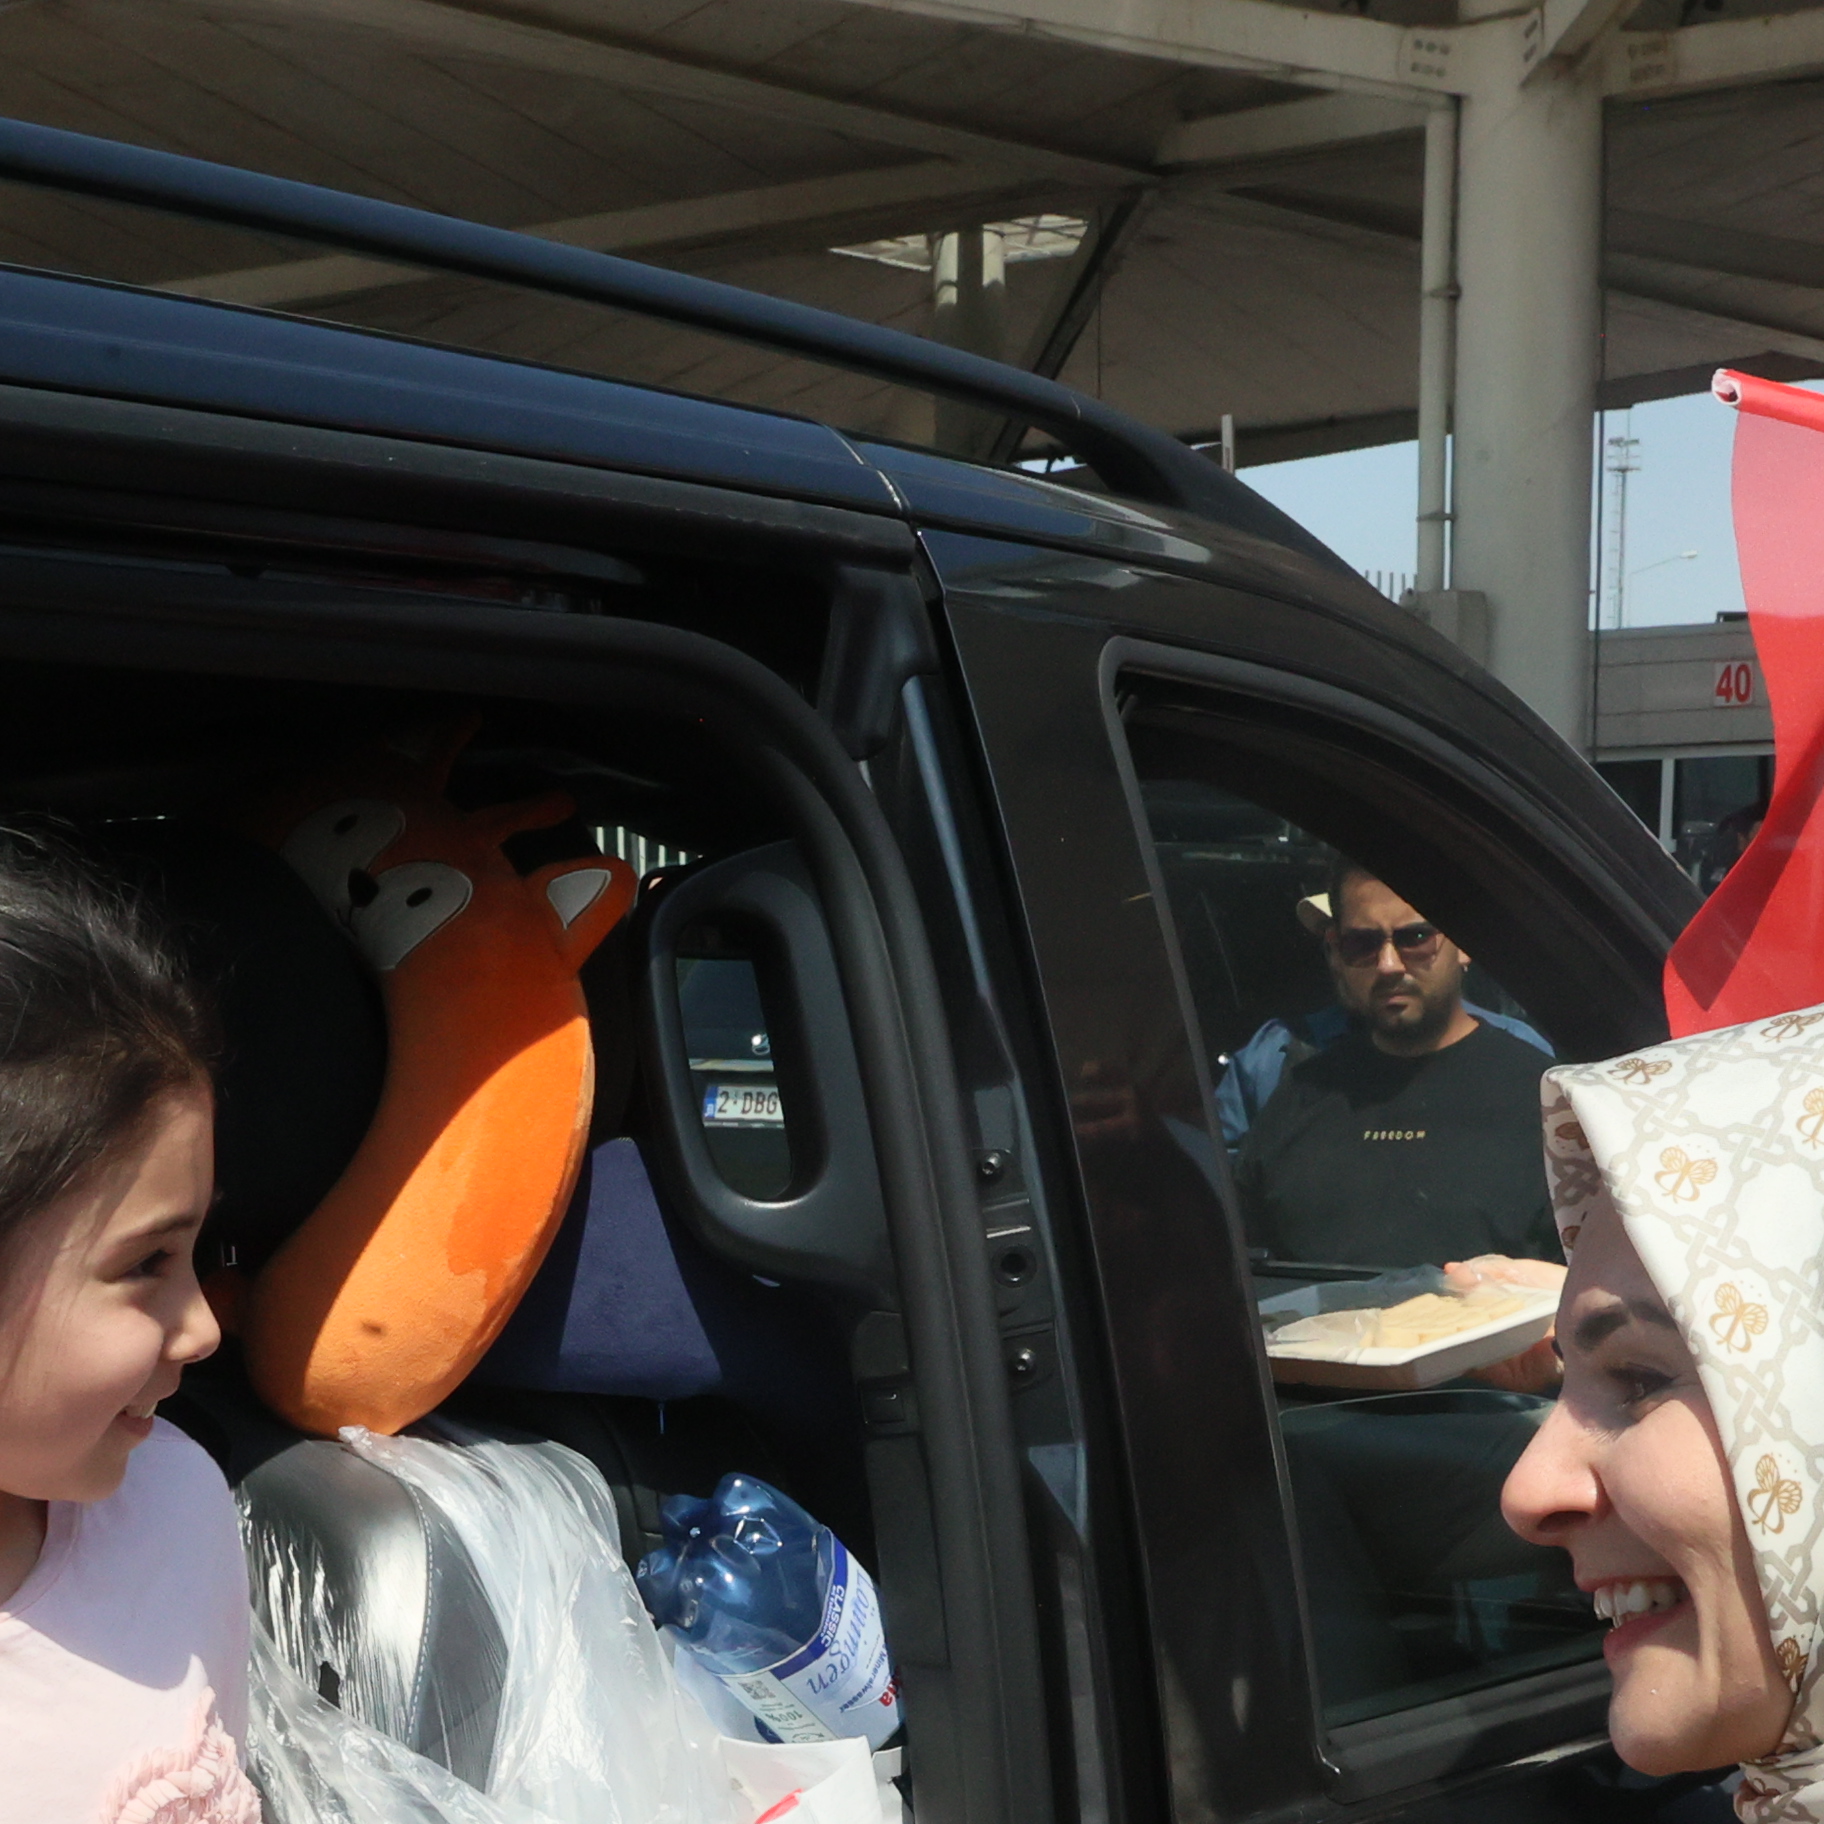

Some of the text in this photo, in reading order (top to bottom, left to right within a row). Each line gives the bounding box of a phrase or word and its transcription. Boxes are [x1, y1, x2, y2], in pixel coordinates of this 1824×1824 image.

[1715, 662, 1752, 703] 40
[1363, 1129, 1427, 1141] FREEDOM
[821, 1584, 845, 1648] CLASSIC
